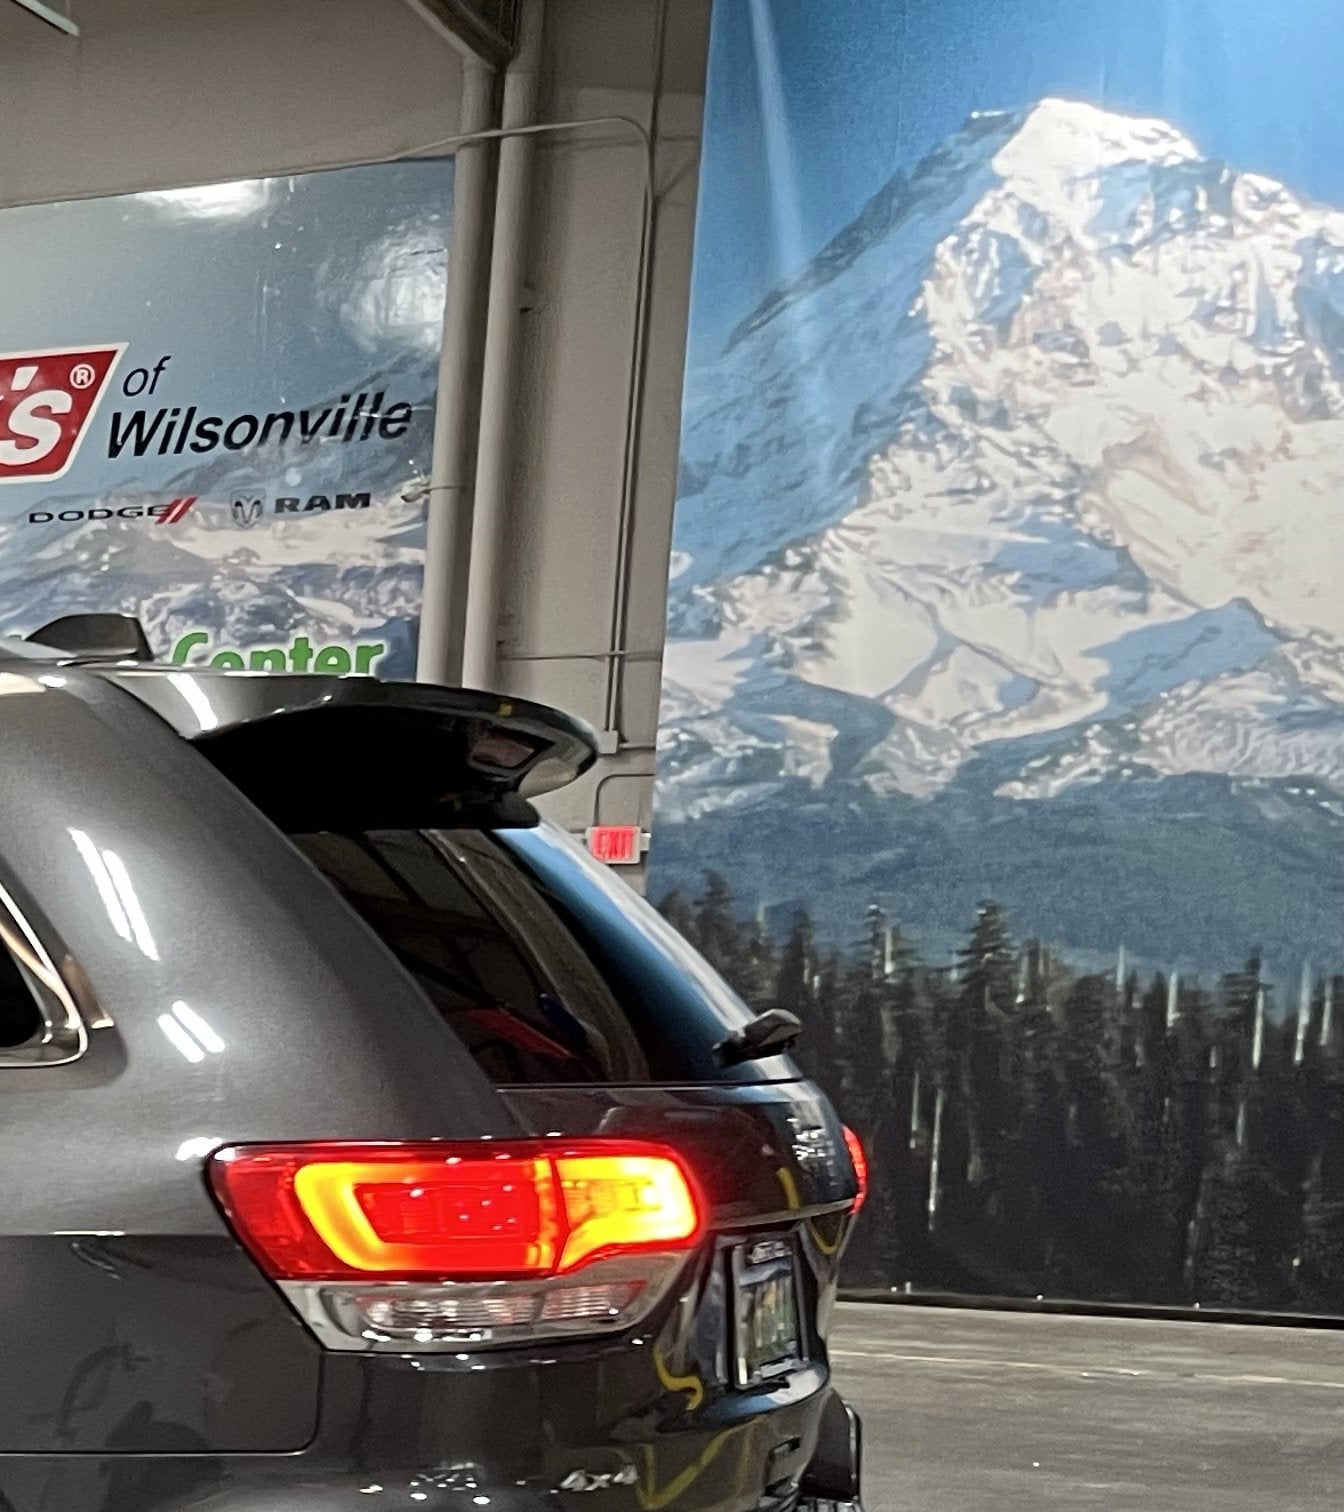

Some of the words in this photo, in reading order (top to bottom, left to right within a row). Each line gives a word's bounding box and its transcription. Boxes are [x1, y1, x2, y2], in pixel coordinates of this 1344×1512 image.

[122, 355, 172, 397] of
[107, 392, 411, 459] Wilsonville
[28, 502, 174, 524] DODGE
[274, 493, 371, 514] RAM
[595, 830, 634, 860] EXIT
